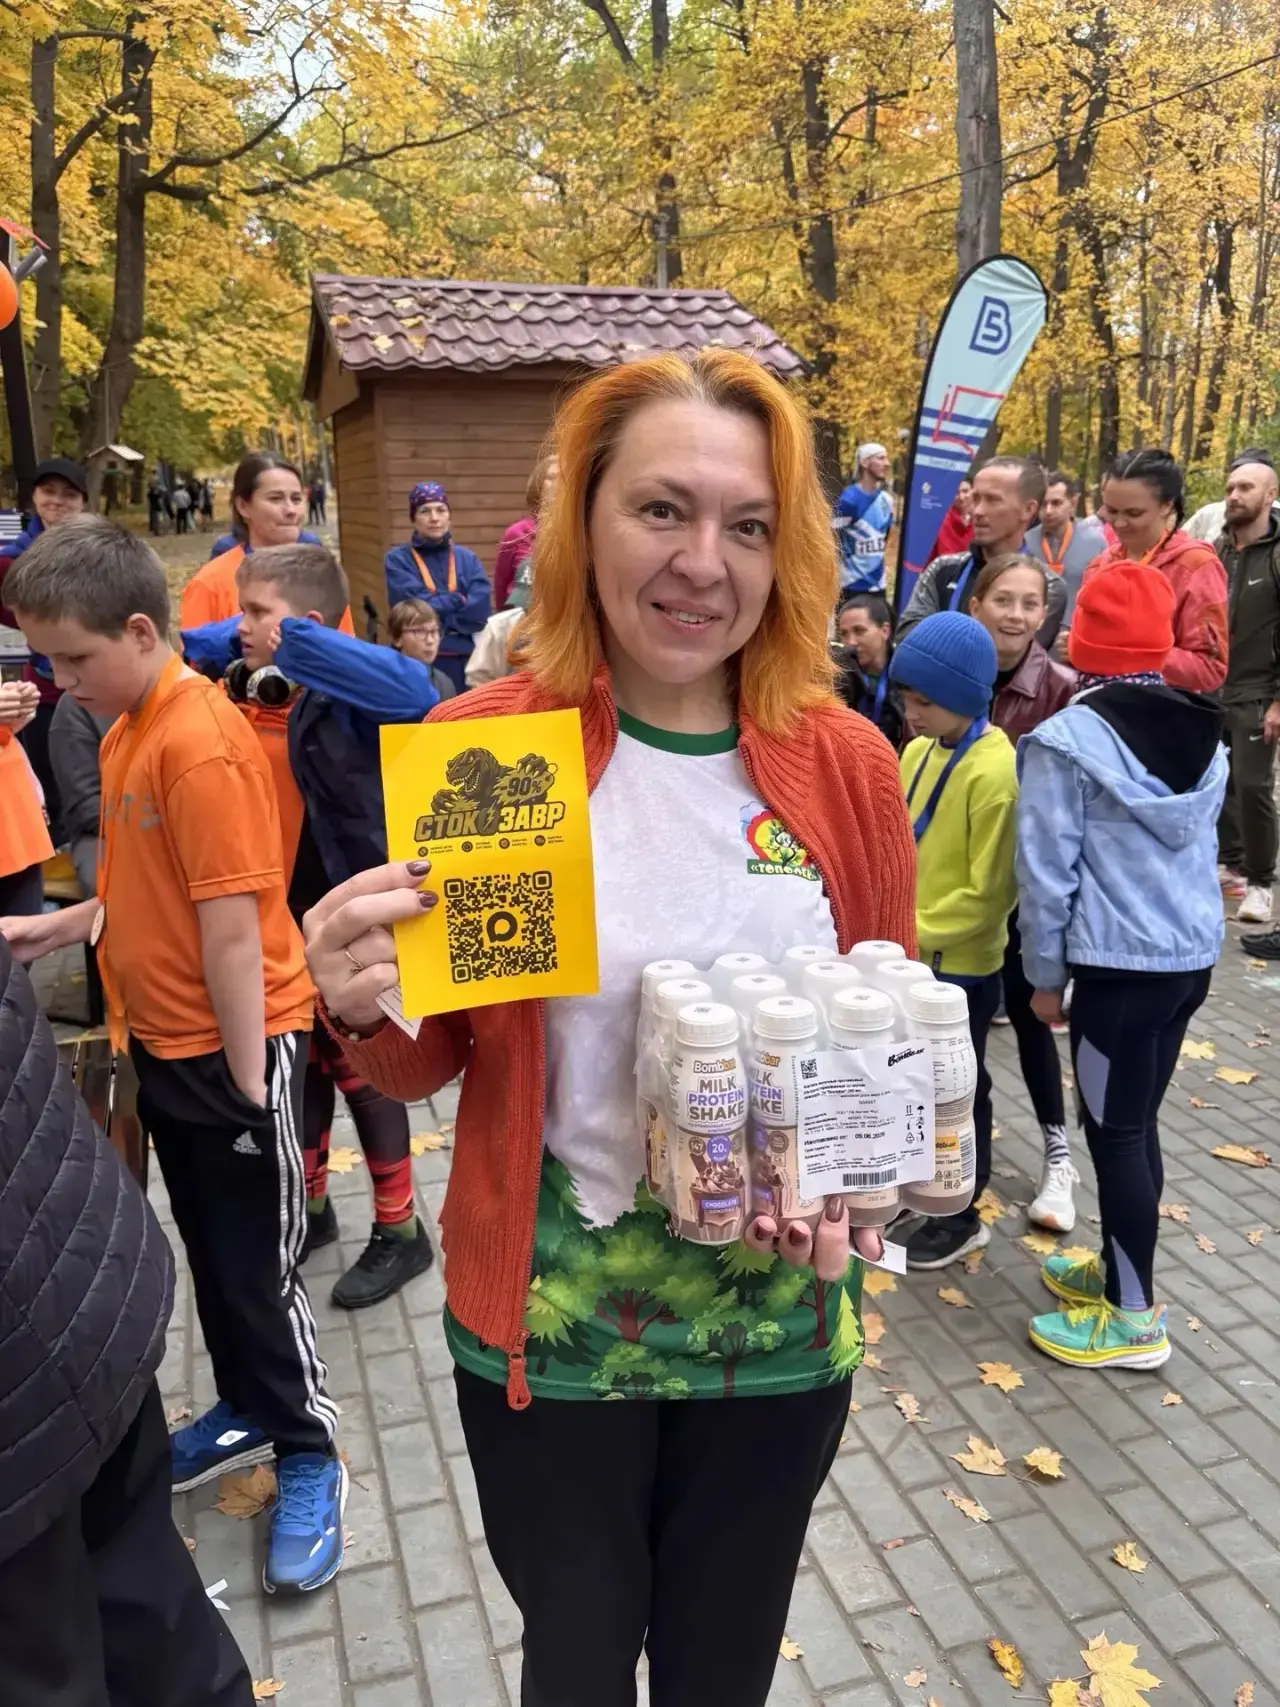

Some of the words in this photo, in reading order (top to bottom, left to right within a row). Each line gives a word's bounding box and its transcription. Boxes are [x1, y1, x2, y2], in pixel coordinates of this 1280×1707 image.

[699, 1075, 737, 1094] MILK
[688, 1087, 744, 1106] PROTEIN
[689, 1101, 745, 1121] SHAKE
[1128, 1328, 1165, 1347] HOKA
